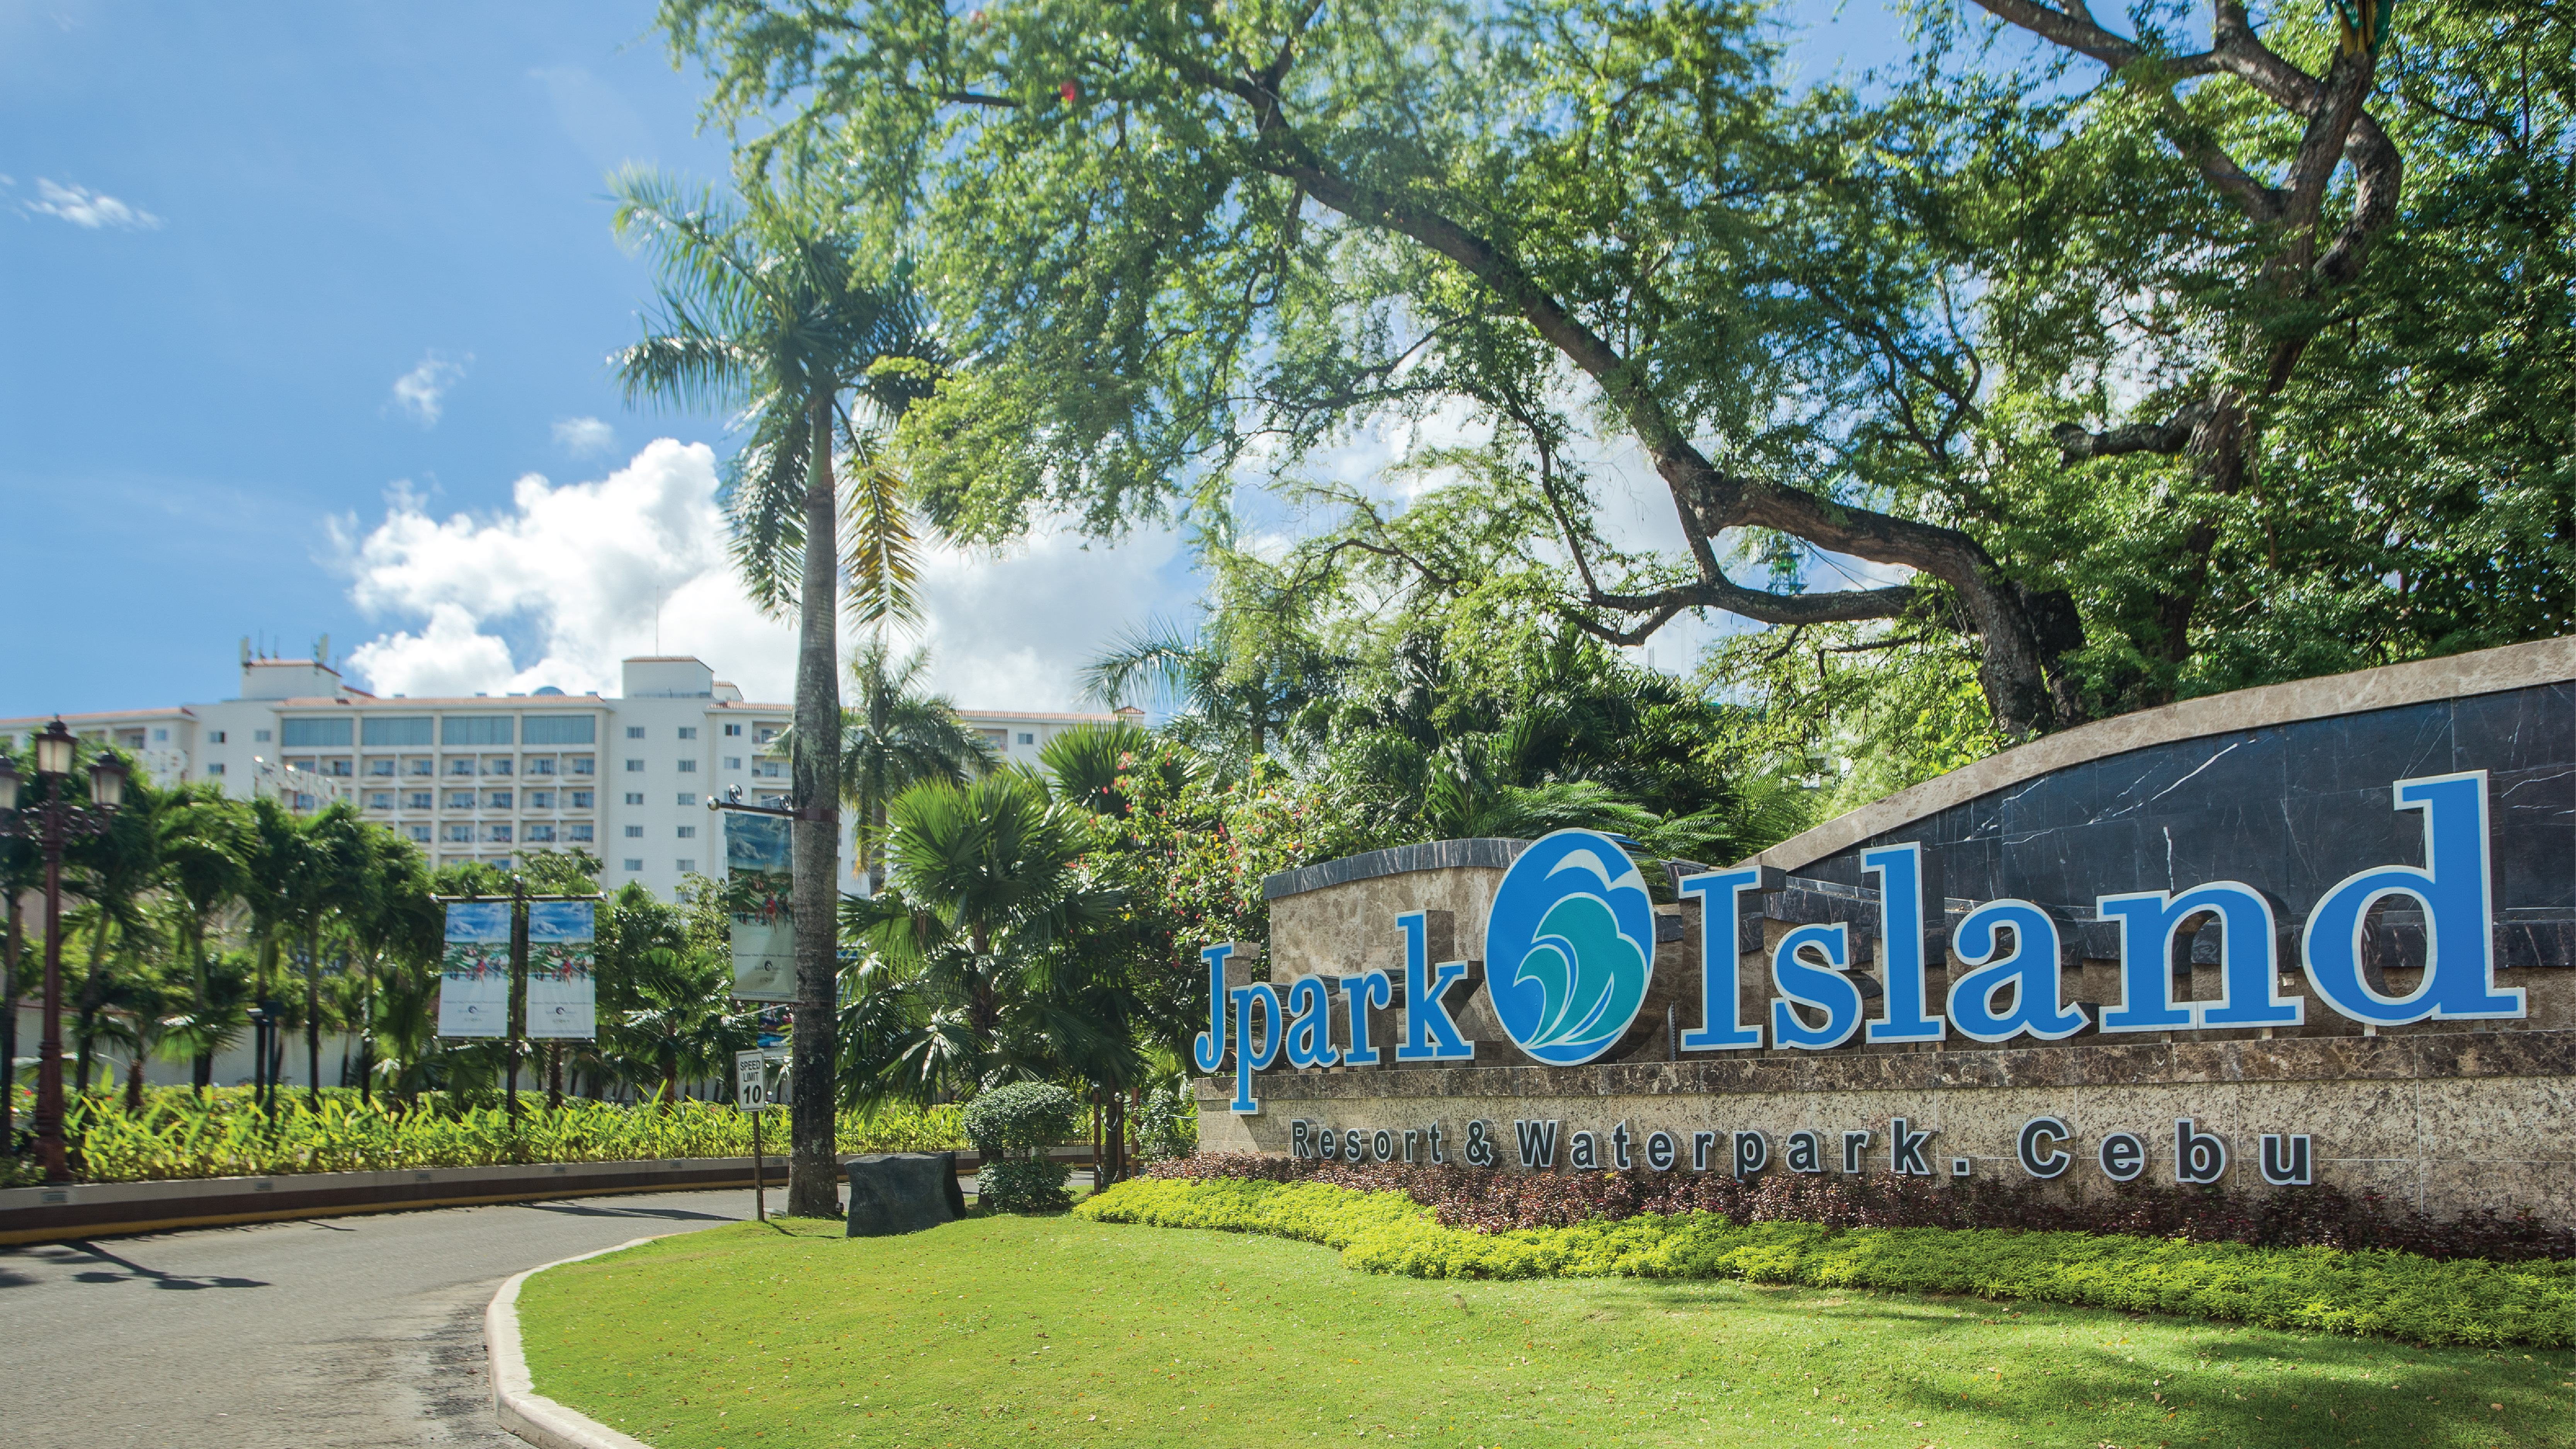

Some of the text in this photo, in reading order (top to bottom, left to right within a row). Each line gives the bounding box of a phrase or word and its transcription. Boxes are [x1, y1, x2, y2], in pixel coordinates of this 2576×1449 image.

[1194, 769, 2527, 1115] Jpark Island
[740, 1060, 761, 1071] SPEED
[743, 1072, 759, 1082] LIMIT
[743, 1085, 762, 1104] 10
[1291, 1119, 1442, 1163] Resort
[1464, 1119, 1493, 1167] &
[2017, 1116, 2312, 1185] Cebu
